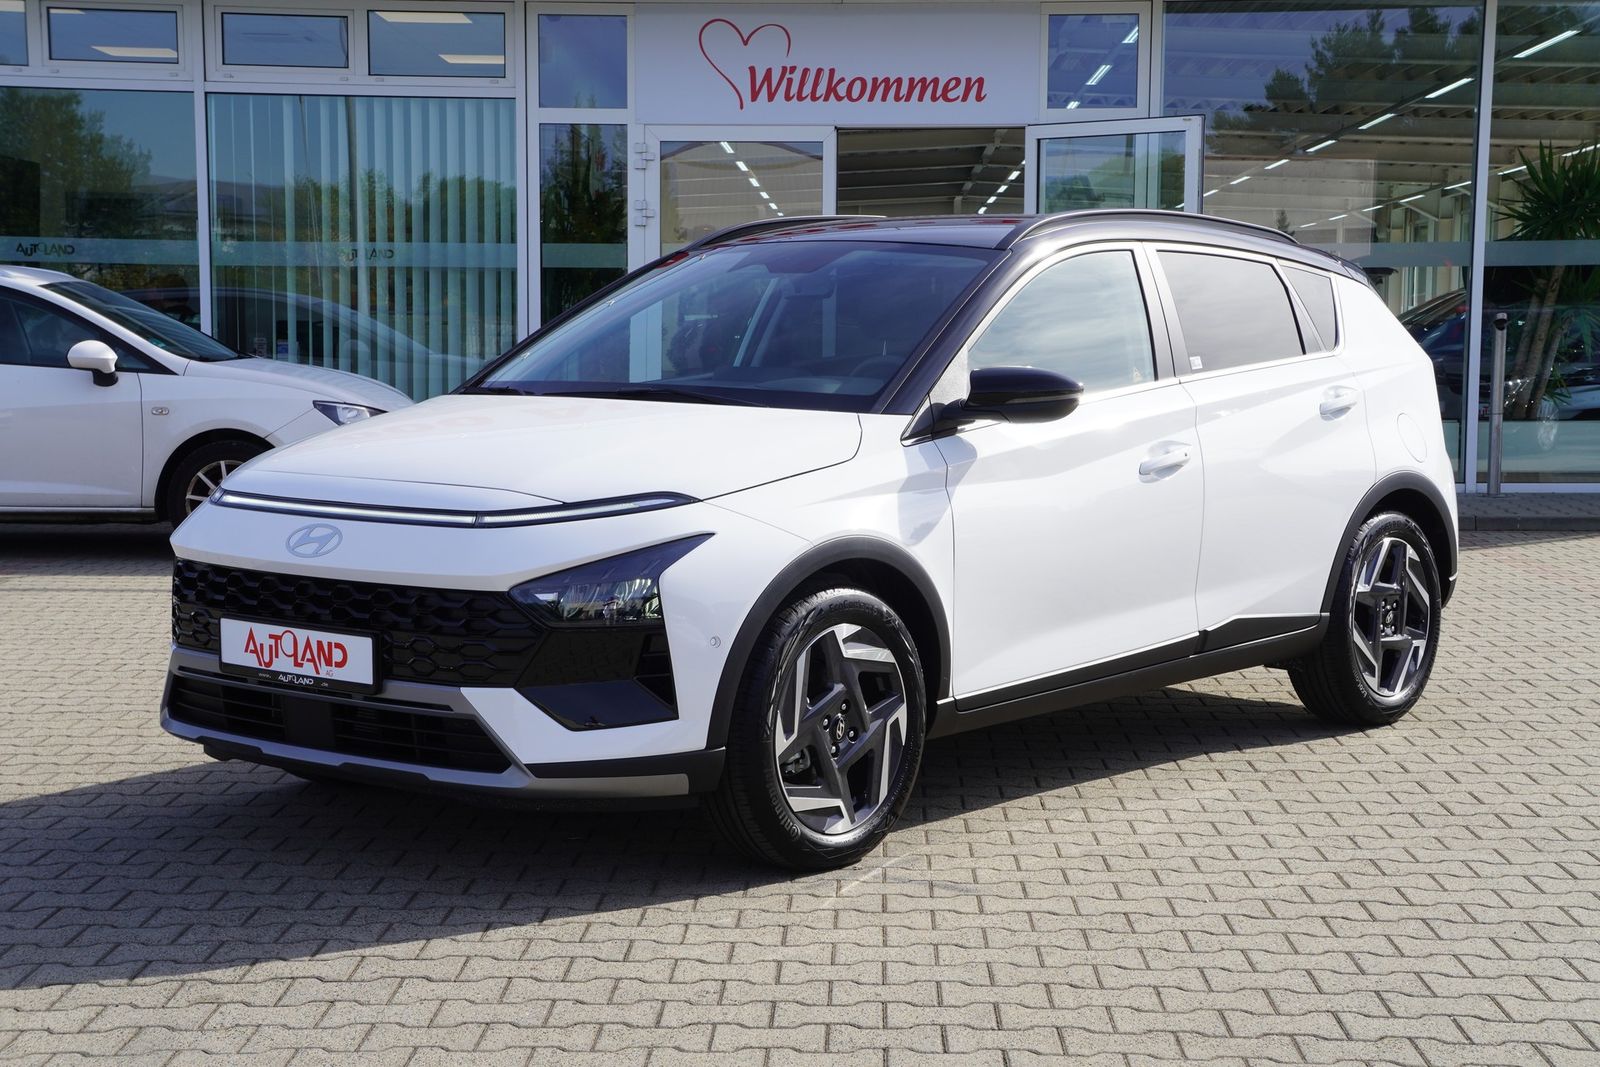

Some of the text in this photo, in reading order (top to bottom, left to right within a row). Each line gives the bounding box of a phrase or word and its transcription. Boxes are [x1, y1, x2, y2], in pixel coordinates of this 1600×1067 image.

[748, 65, 987, 103] Willkommen
[244, 627, 348, 675] AUTOLAND
[278, 673, 314, 685] AUTOLAND
